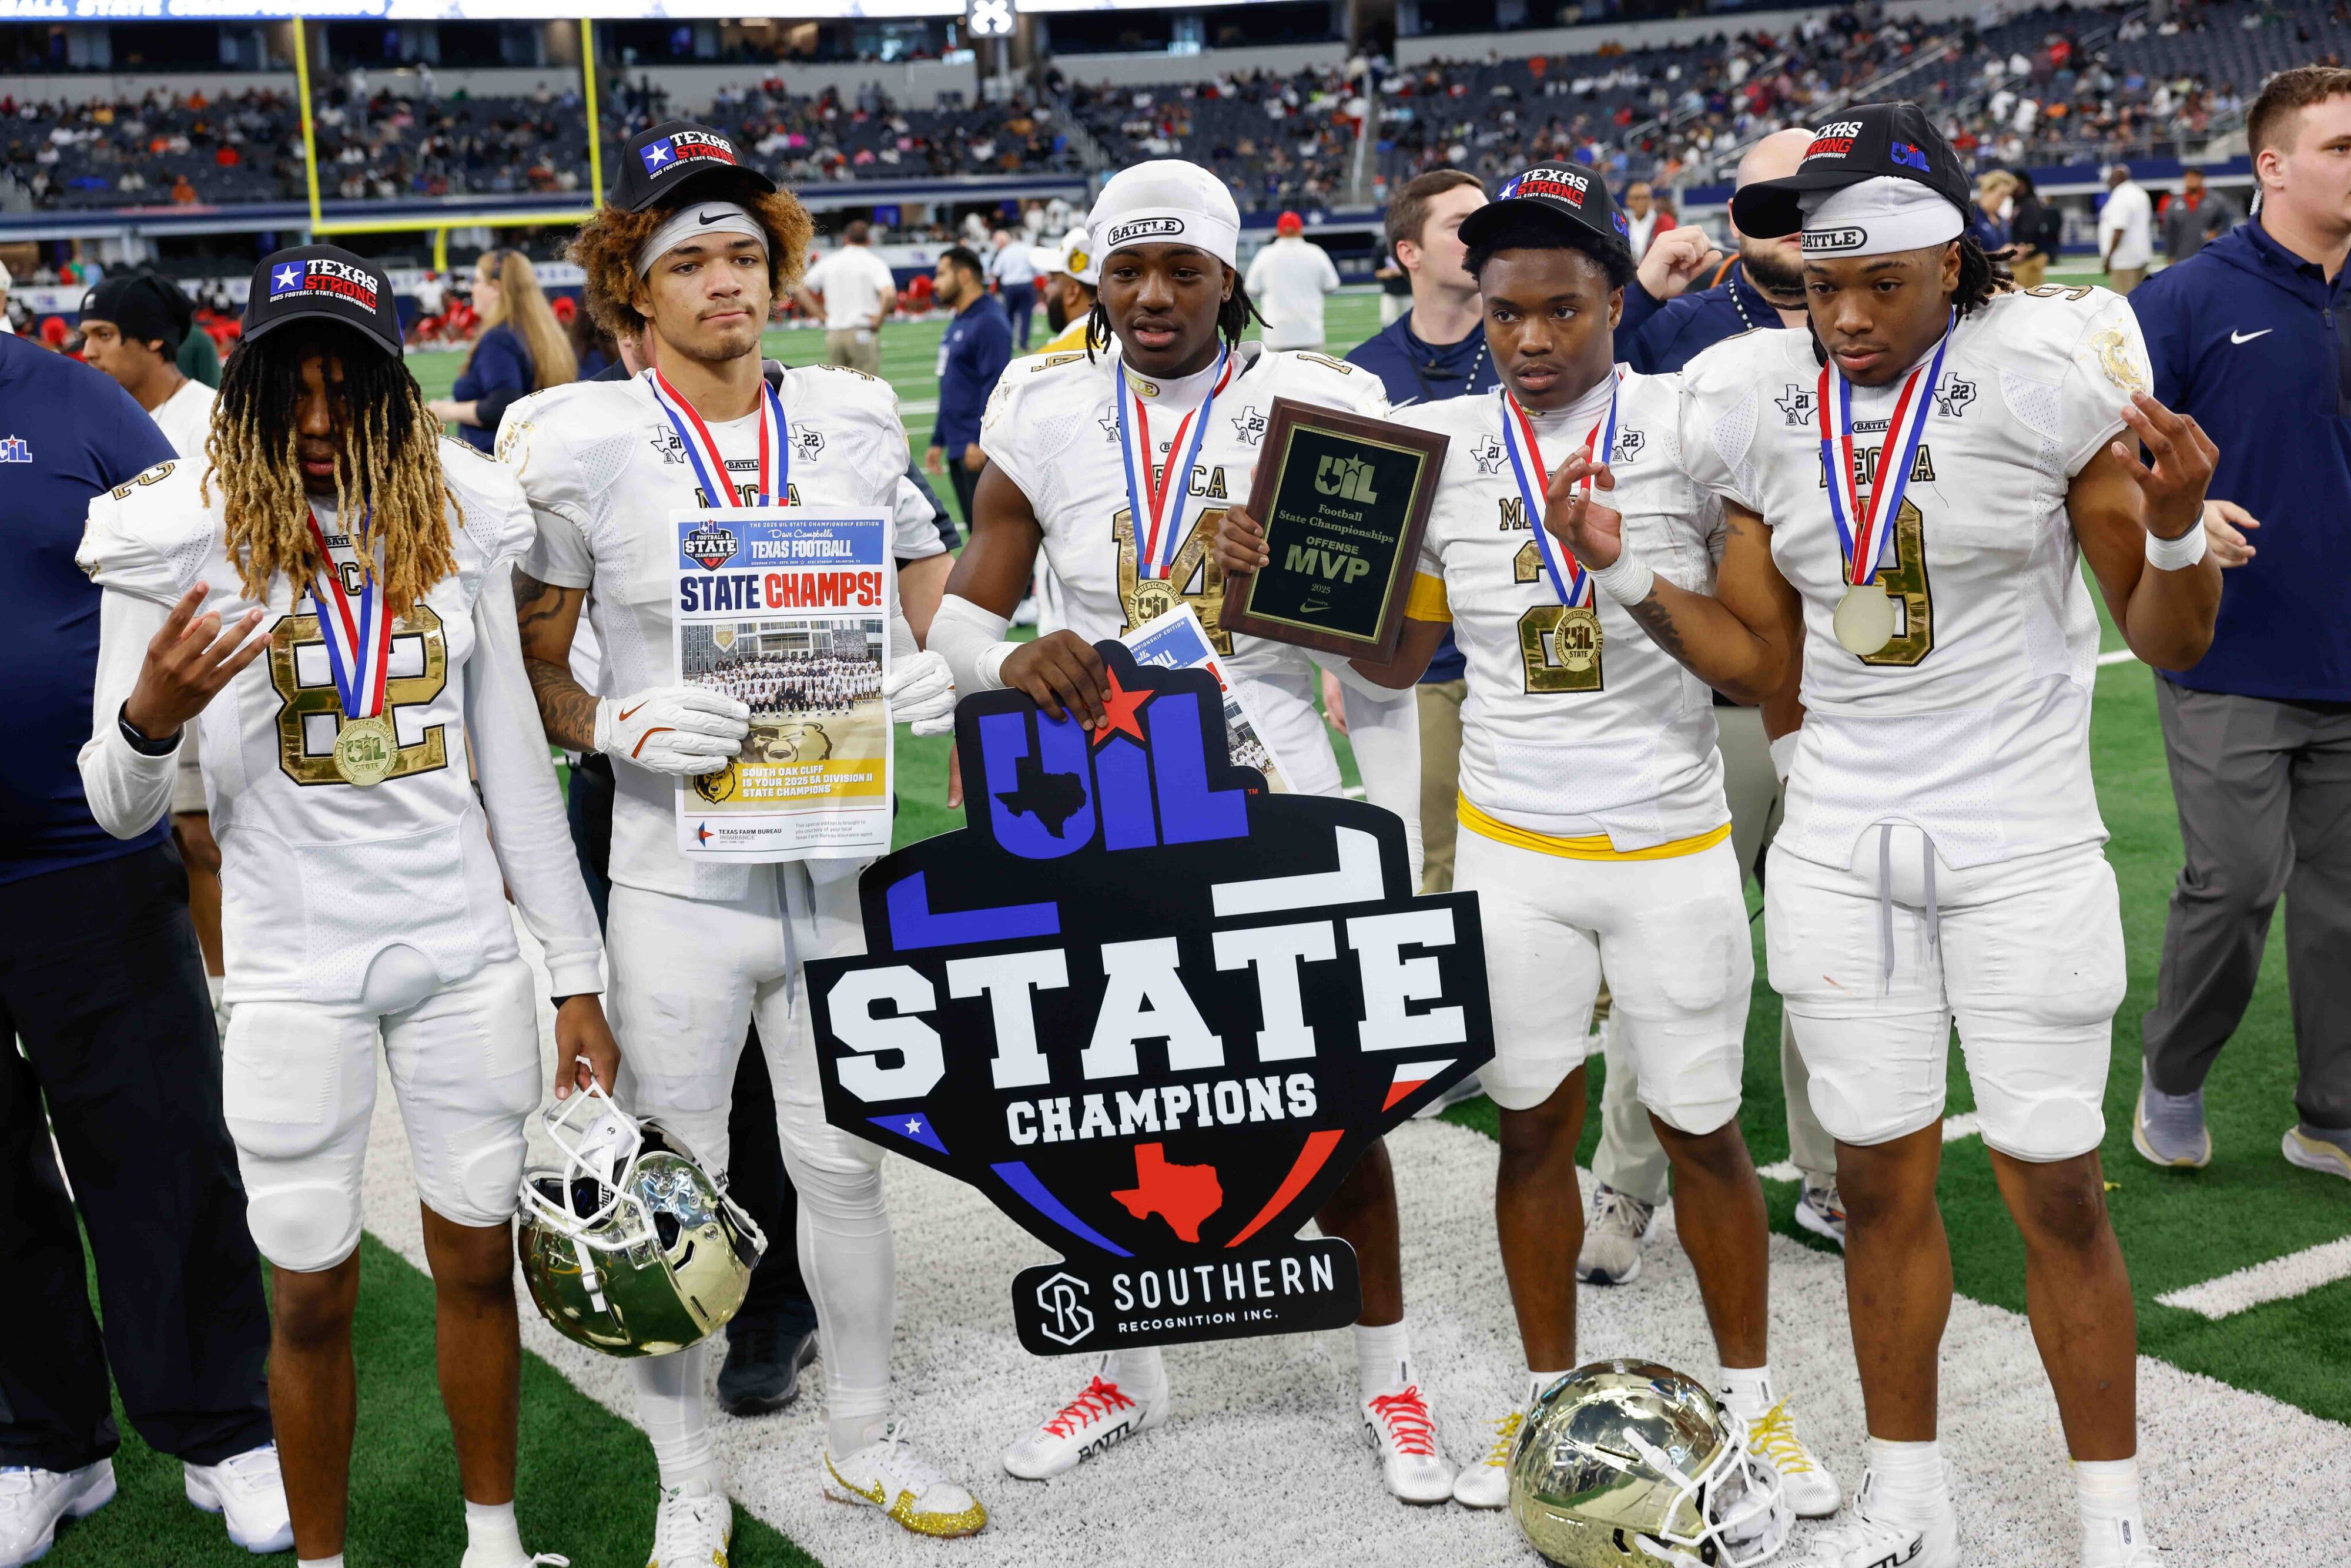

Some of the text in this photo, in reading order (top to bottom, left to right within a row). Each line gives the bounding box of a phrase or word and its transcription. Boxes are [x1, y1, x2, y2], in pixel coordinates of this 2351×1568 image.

[669, 131, 732, 154] TEXAS
[675, 144, 737, 166] STRONG
[649, 170, 663, 180] 2025
[663, 158, 689, 172] FOOTBALL
[1522, 169, 1589, 192] TEXAS
[1516, 180, 1584, 205] STRONG
[1540, 193, 1581, 210] CHAMPIONSHIPS
[1113, 221, 1176, 242] BATTLE
[1802, 232, 1856, 247] BATTLE
[307, 259, 378, 294] TEXAS
[270, 294, 283, 303] 2025
[284, 290, 313, 298] FOOTBALL
[335, 293, 376, 315] CHAMPIONSHIPS
[304, 275, 376, 308] STRONG
[1795, 395, 1809, 408] 21
[1950, 384, 1970, 400] 22
[1248, 417, 1264, 431] 22
[1856, 421, 1890, 431] BATTL
[669, 437, 682, 449] 21
[803, 434, 819, 446] 22
[1623, 434, 1639, 447] 22
[1487, 447, 1499, 458] 21
[1318, 504, 1363, 522] Football
[767, 528, 834, 540] Dave Campbell's
[1278, 510, 1394, 544] State Championships
[685, 540, 736, 553] STATE
[751, 540, 853, 559] TEXAS FOOTBALL
[1306, 535, 1359, 555] OFFENSE
[1284, 544, 1370, 584] MVP
[681, 571, 882, 612] STATE CHAMPS!
[1113, 508, 1234, 656] 14
[1311, 583, 1331, 594] 2025
[1842, 496, 1934, 666] 9
[1134, 582, 1182, 605] INTERSCHOLASTIC
[1513, 540, 1605, 695] 2
[1131, 620, 1185, 653] AMPIONSHIP EDITION
[269, 604, 448, 786] 82
[742, 765, 824, 777] SOUTH OAK CLIFF
[742, 773, 873, 788] IS YOUR 2025 5A DIVISION II
[742, 785, 831, 798] STATE CHAMPIONS
[826, 907, 1468, 1103] STATE
[1006, 1073, 1317, 1146] CHAMPIONS
[1112, 1254, 1334, 1311] SOUTHERN
[1118, 1308, 1279, 1333] RECOGNITION INC.
